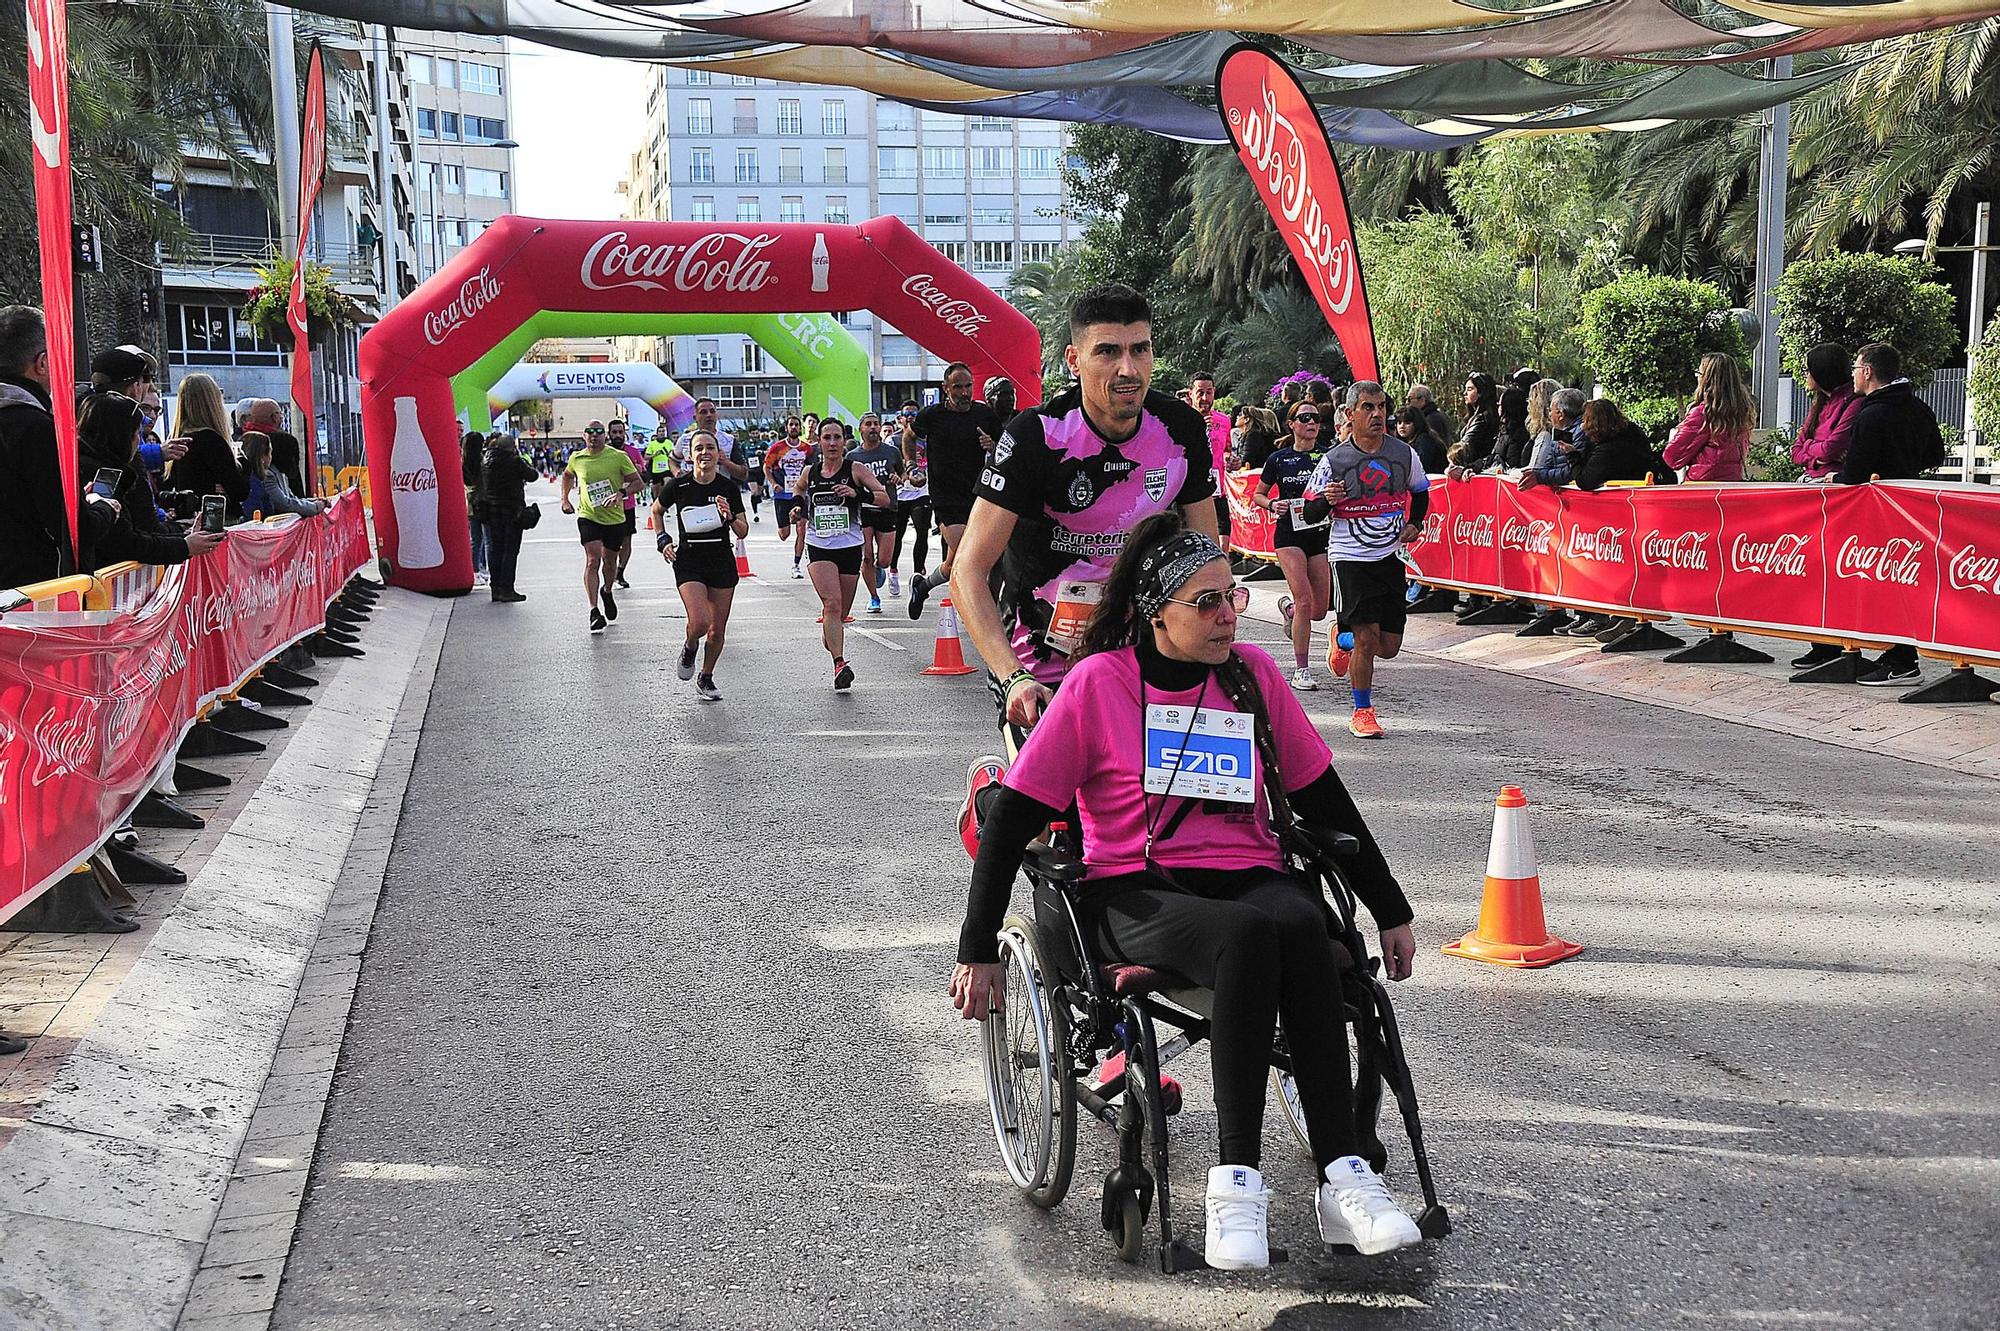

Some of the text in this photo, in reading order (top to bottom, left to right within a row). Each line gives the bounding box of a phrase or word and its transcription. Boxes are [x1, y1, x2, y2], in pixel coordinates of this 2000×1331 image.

[581, 231, 782, 292] Coca-Cola
[423, 264, 504, 346] Coca-Cola
[901, 273, 992, 339] Coca-Cola
[778, 313, 833, 360] CRC
[557, 373, 625, 385] EVENTOS
[820, 520, 845, 530] 5105
[1454, 513, 1495, 548] Coca-Cola
[1501, 516, 1555, 556] Coca-Cola
[1567, 524, 1627, 564] Coca-Cola
[1051, 540, 1124, 558] antonio garc
[1641, 529, 1710, 571] Coca-Cola
[1731, 532, 1812, 577] Coca-Cola
[1836, 534, 1924, 586] Coca-Cola
[1949, 544, 2000, 596] Coca-
[1161, 747, 1239, 777] 5710
